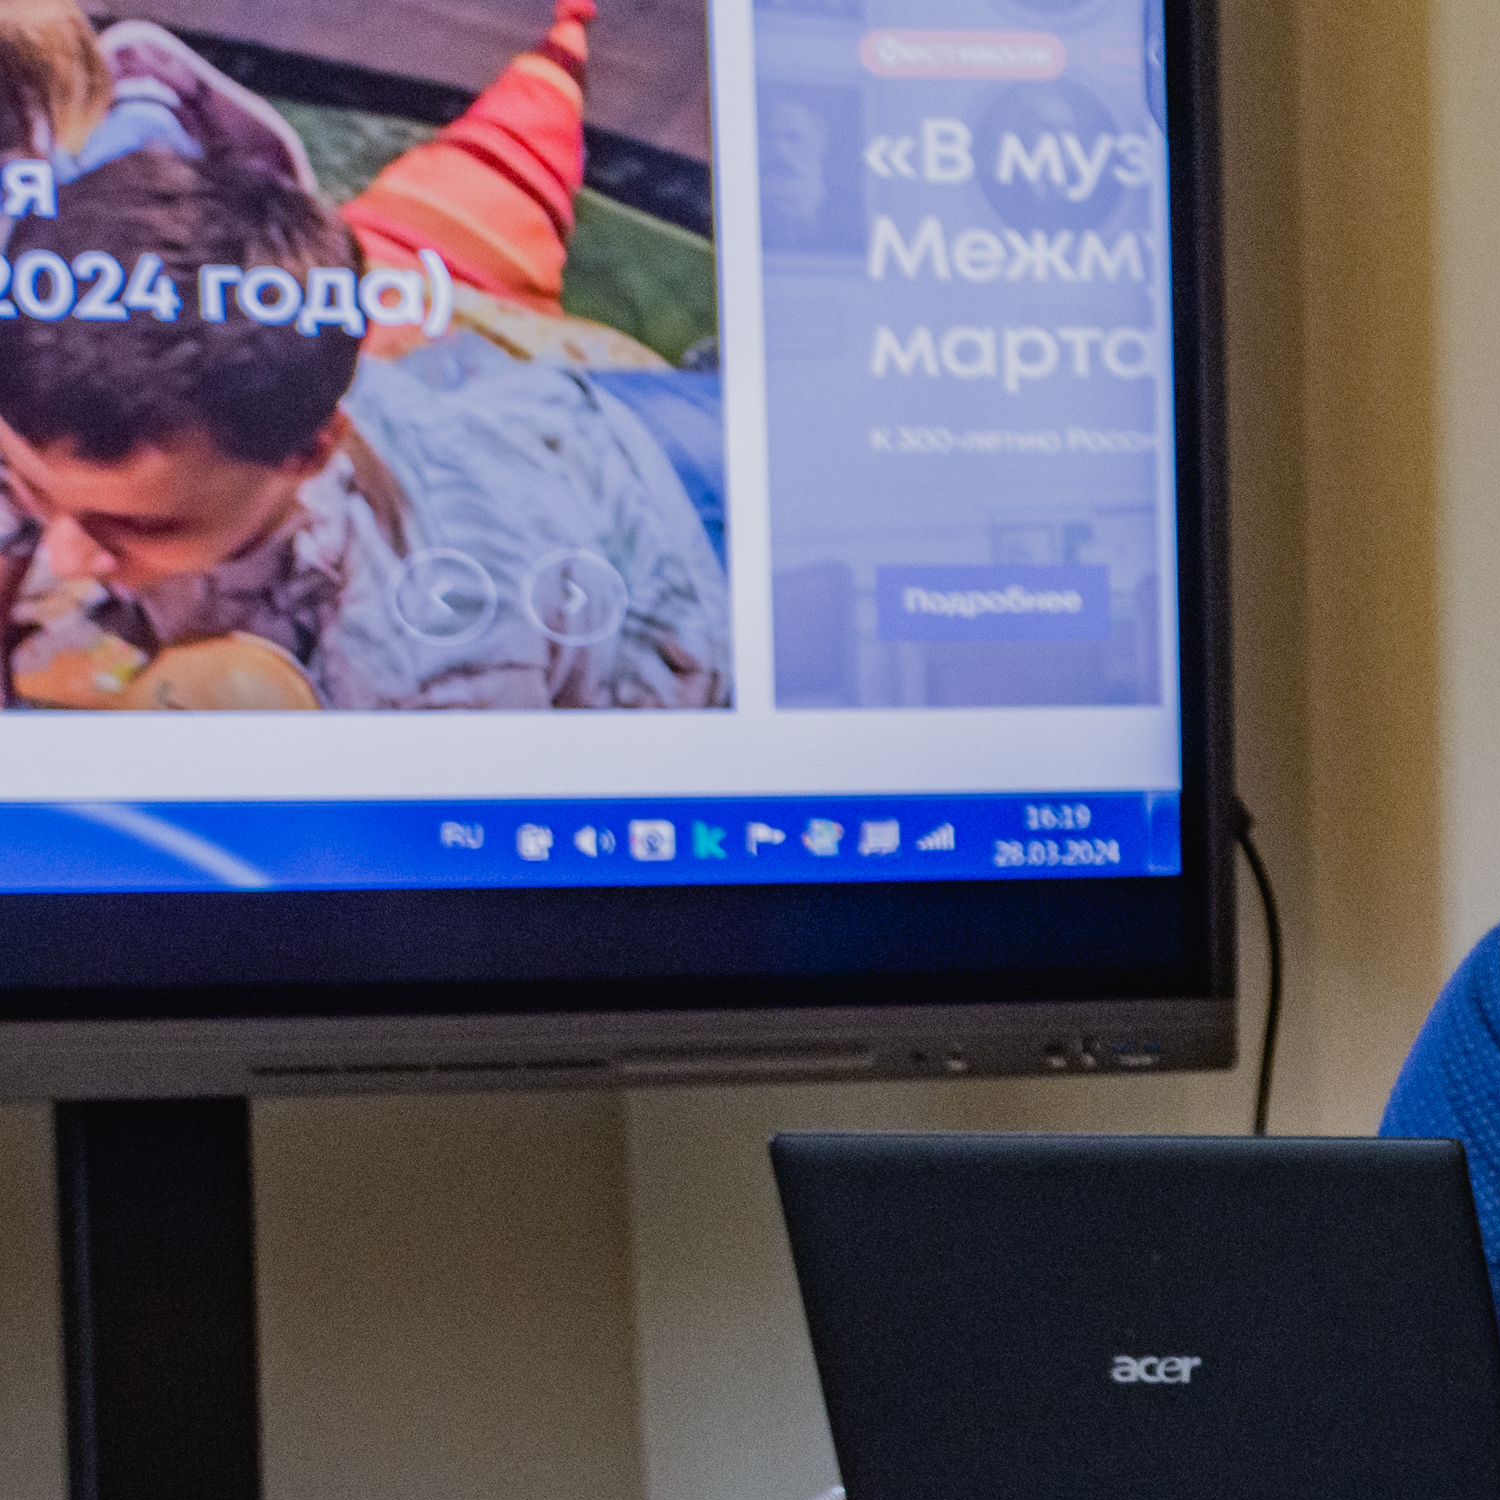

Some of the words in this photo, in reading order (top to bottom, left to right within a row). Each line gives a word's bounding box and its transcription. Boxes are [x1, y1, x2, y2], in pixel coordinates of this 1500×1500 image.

[864, 117, 976, 185] «В
[996, 131, 1156, 202] муз
[868, 213, 1157, 298] Межм
[0, 249, 183, 323] 024
[198, 249, 455, 337] года)
[902, 585, 1085, 620] Подробнее
[439, 820, 485, 849] RU
[993, 838, 1121, 868] 28.03.2024
[1111, 1355, 1202, 1384] acer
